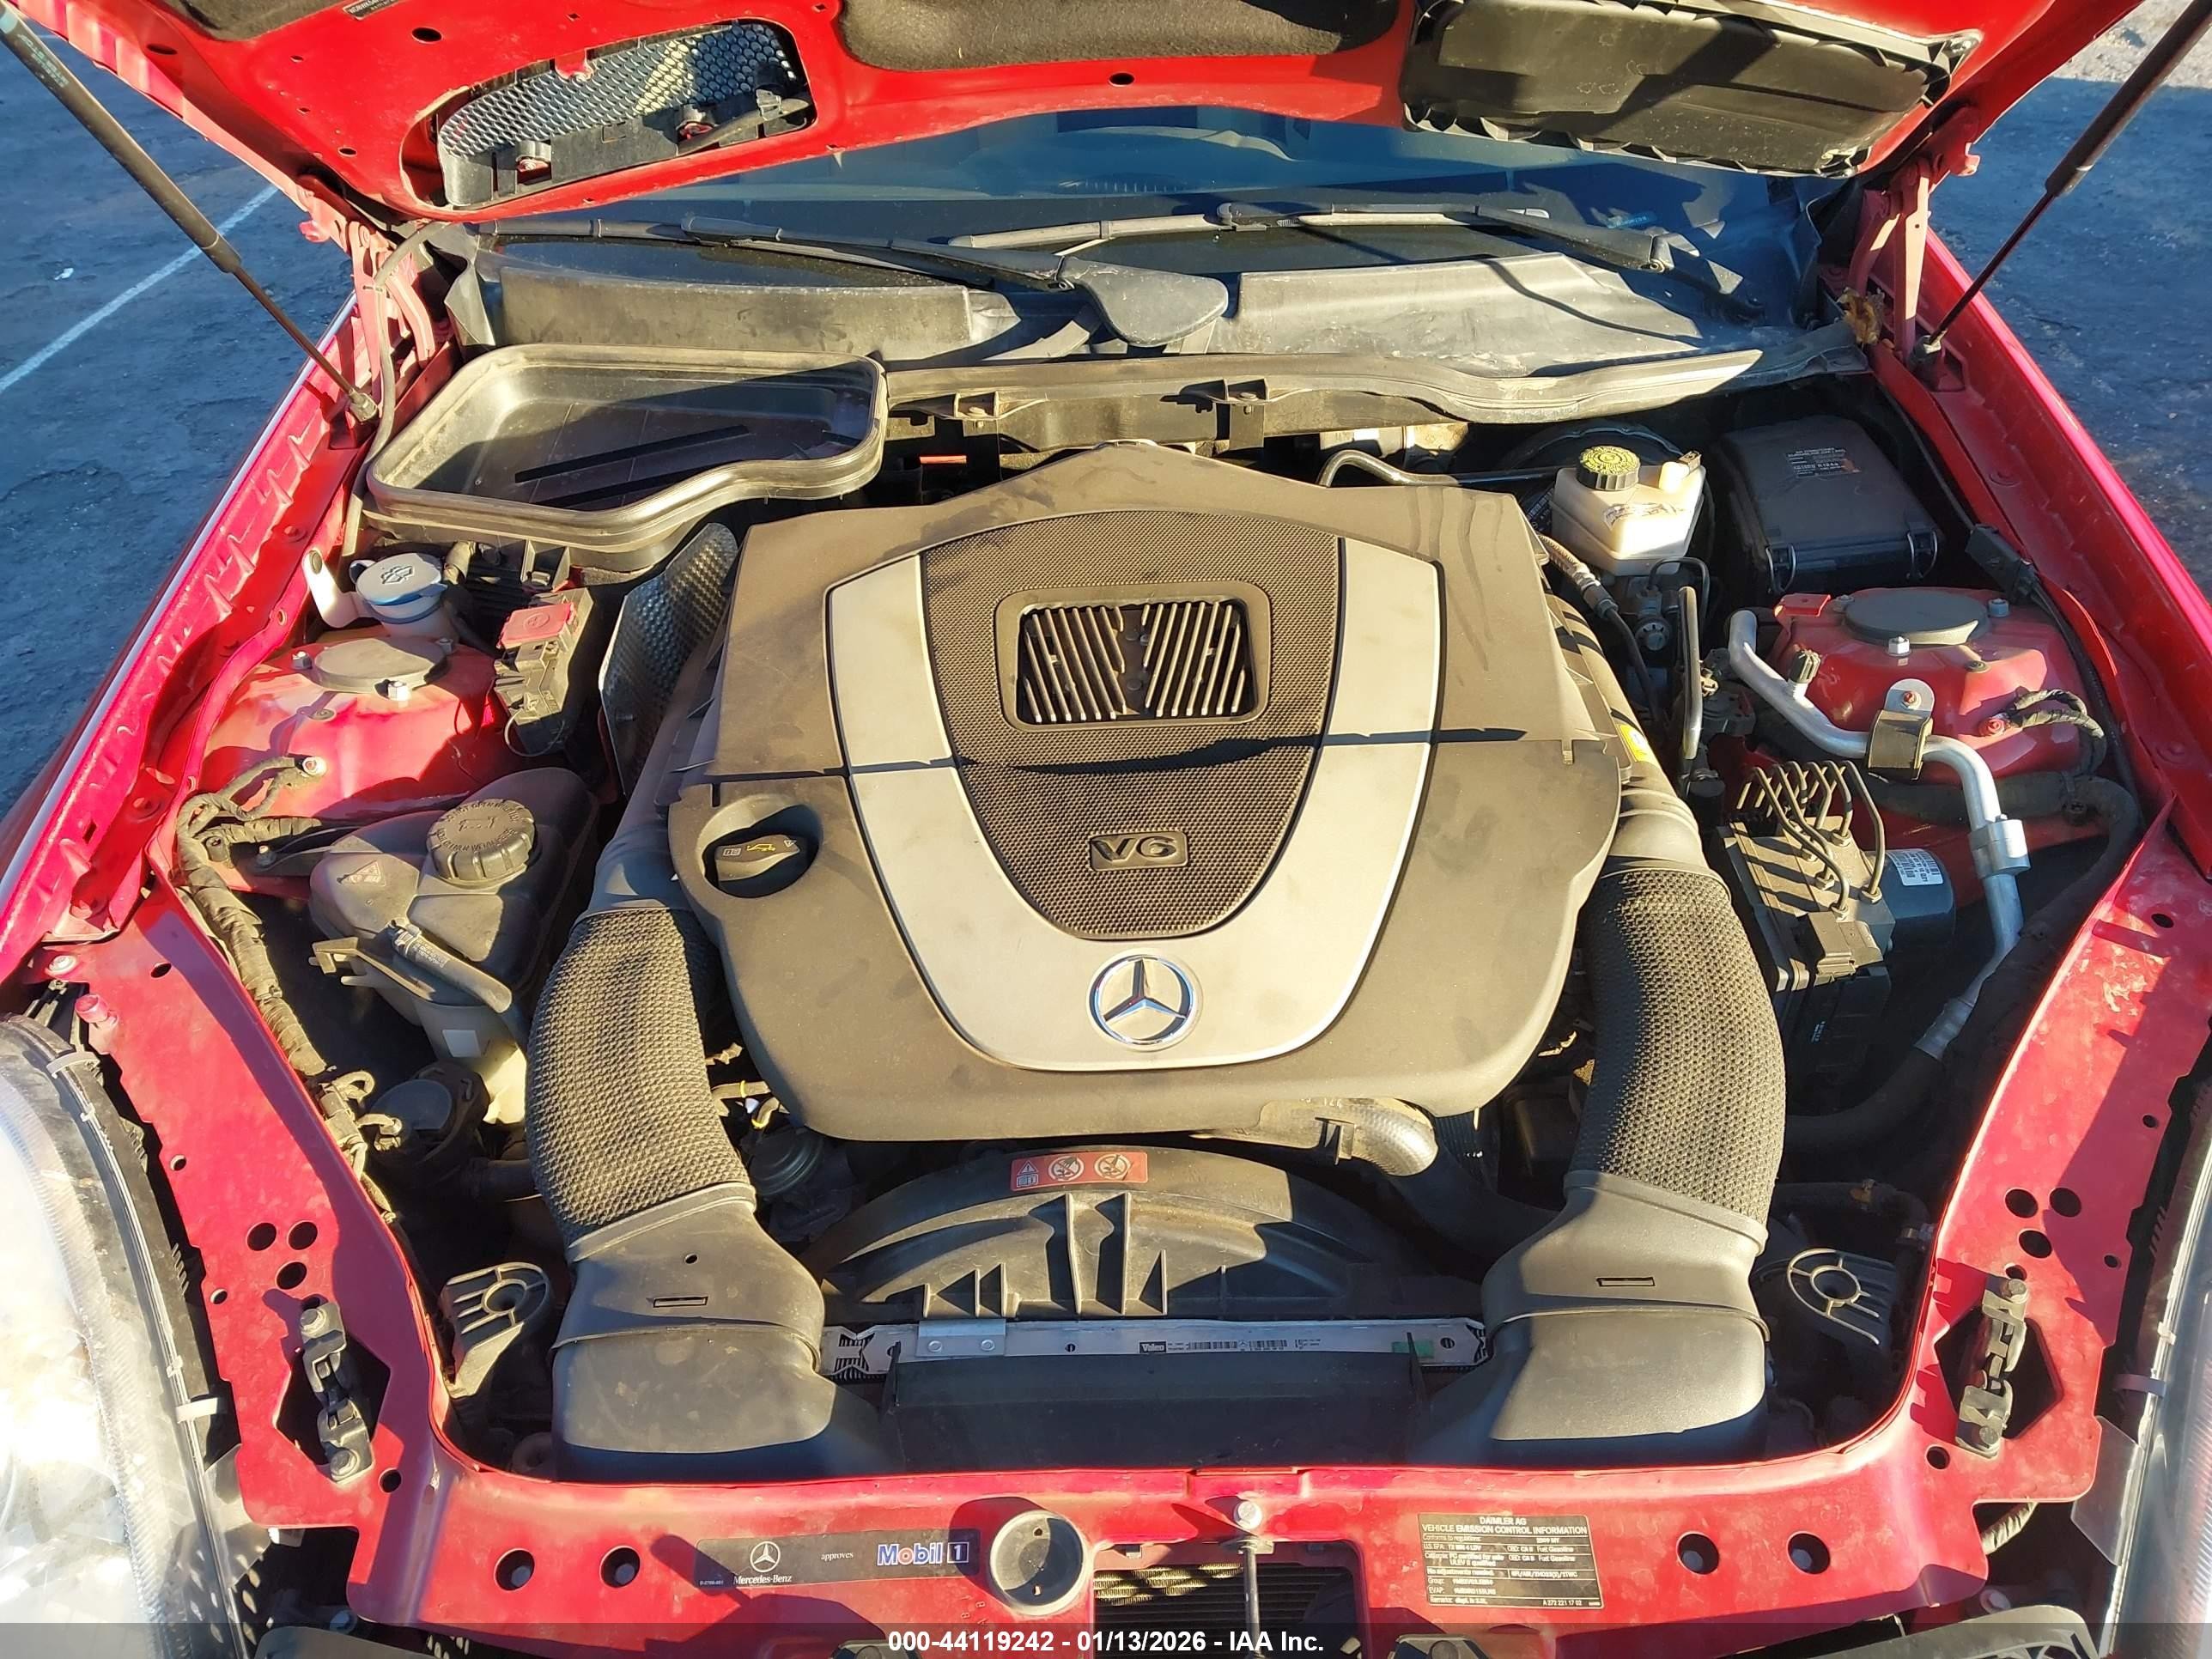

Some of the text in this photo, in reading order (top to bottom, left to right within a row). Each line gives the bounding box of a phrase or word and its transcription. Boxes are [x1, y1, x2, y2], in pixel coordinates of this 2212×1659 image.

[1091, 836, 1177, 861] V6
[1479, 1516, 1527, 1525] DAIMLER AG
[1455, 1525, 1493, 1534] EMISSION
[1494, 1525, 1532, 1534] CONTROL
[1533, 1526, 1587, 1534] INFORMATION
[820, 1552, 854, 1562] approves
[877, 1542, 943, 1565] Mobil
[733, 1574, 792, 1585] Mercedes-Benz
